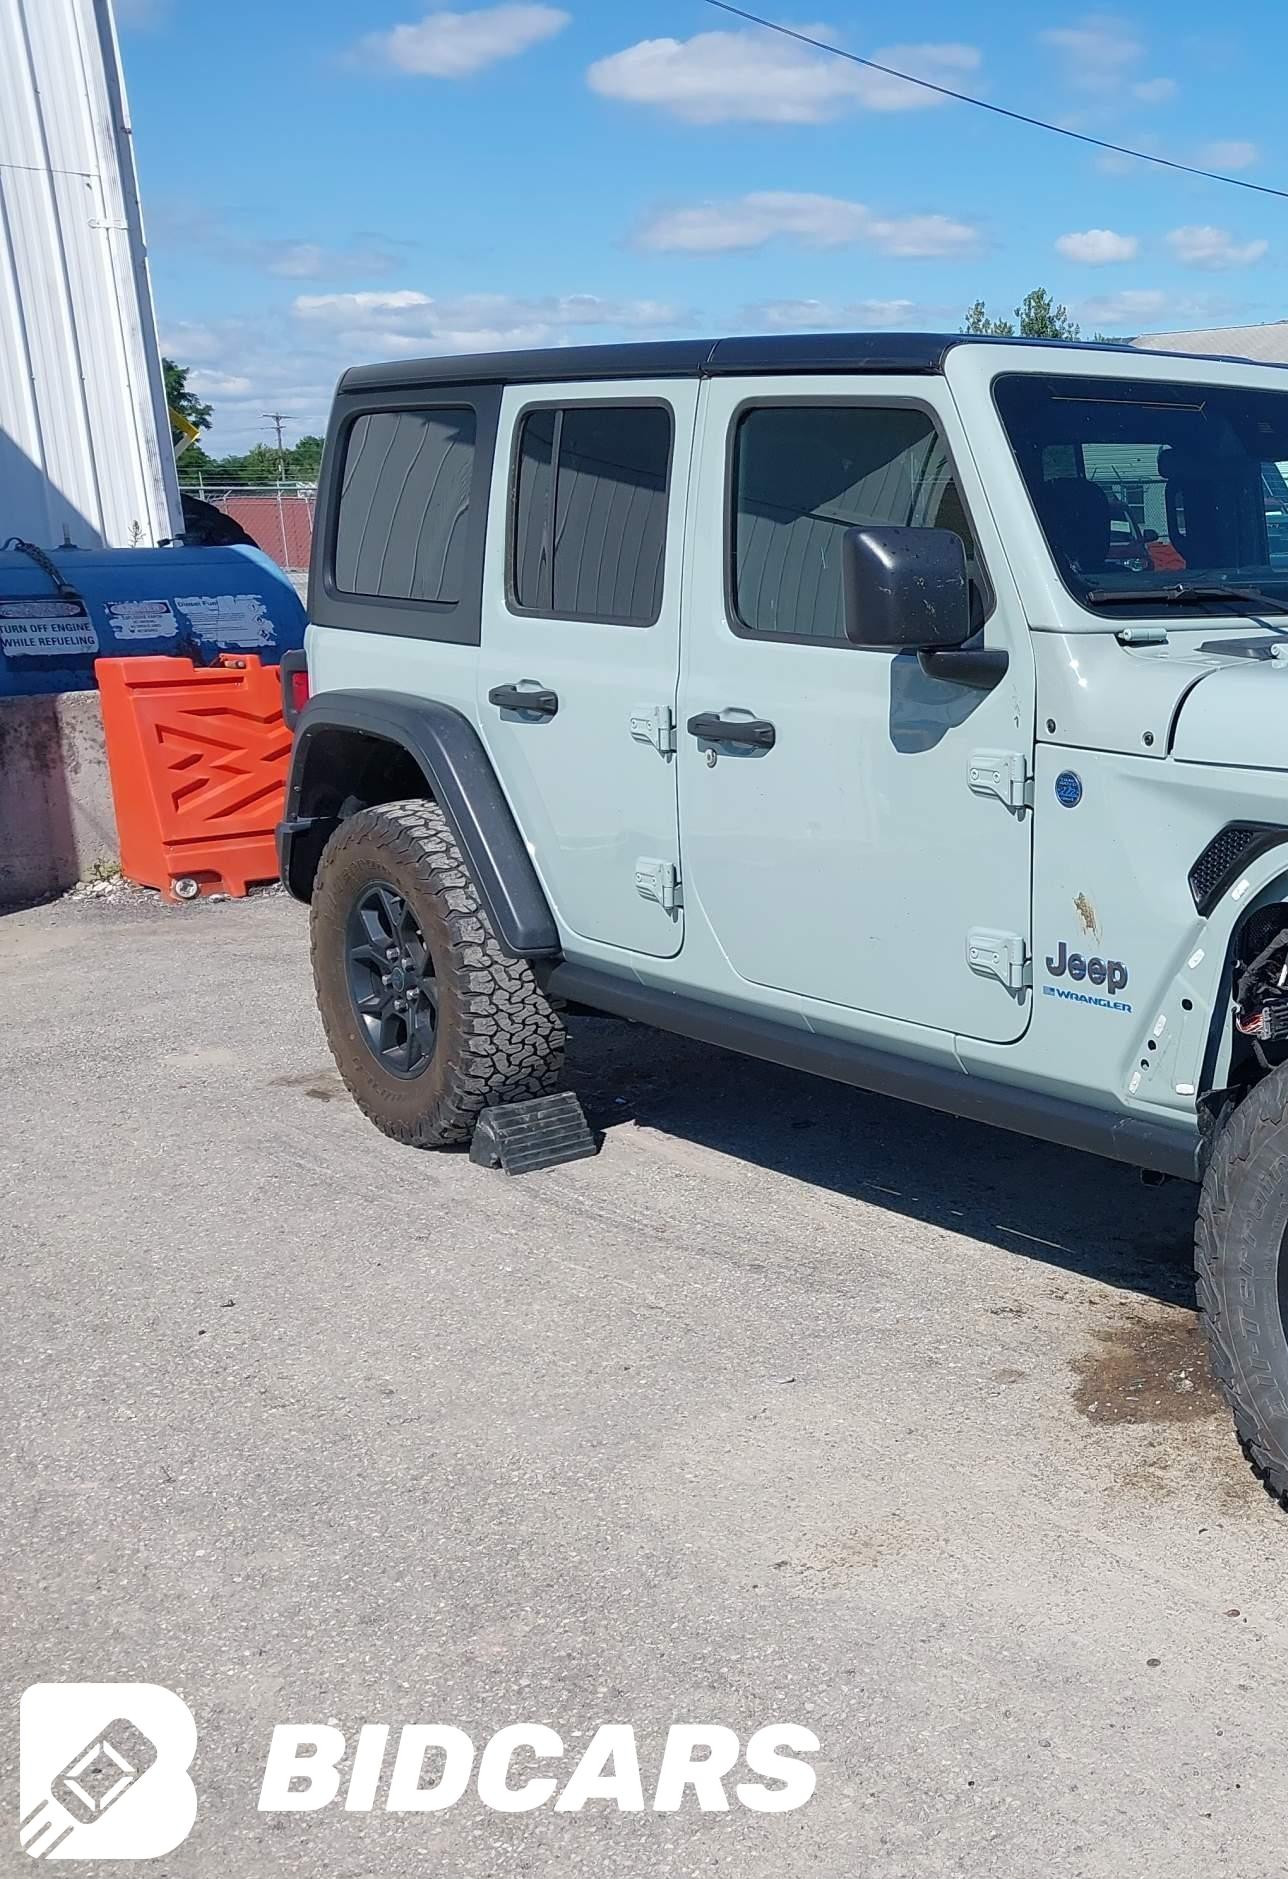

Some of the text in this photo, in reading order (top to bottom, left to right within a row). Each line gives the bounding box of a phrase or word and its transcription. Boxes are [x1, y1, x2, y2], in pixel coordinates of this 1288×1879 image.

[0, 622, 92, 634] TURN OFF ENGINE
[1, 636, 95, 647] WHILE REFUELING
[1045, 941, 1128, 995] Jeep
[1056, 987, 1132, 1013] WRANGLER
